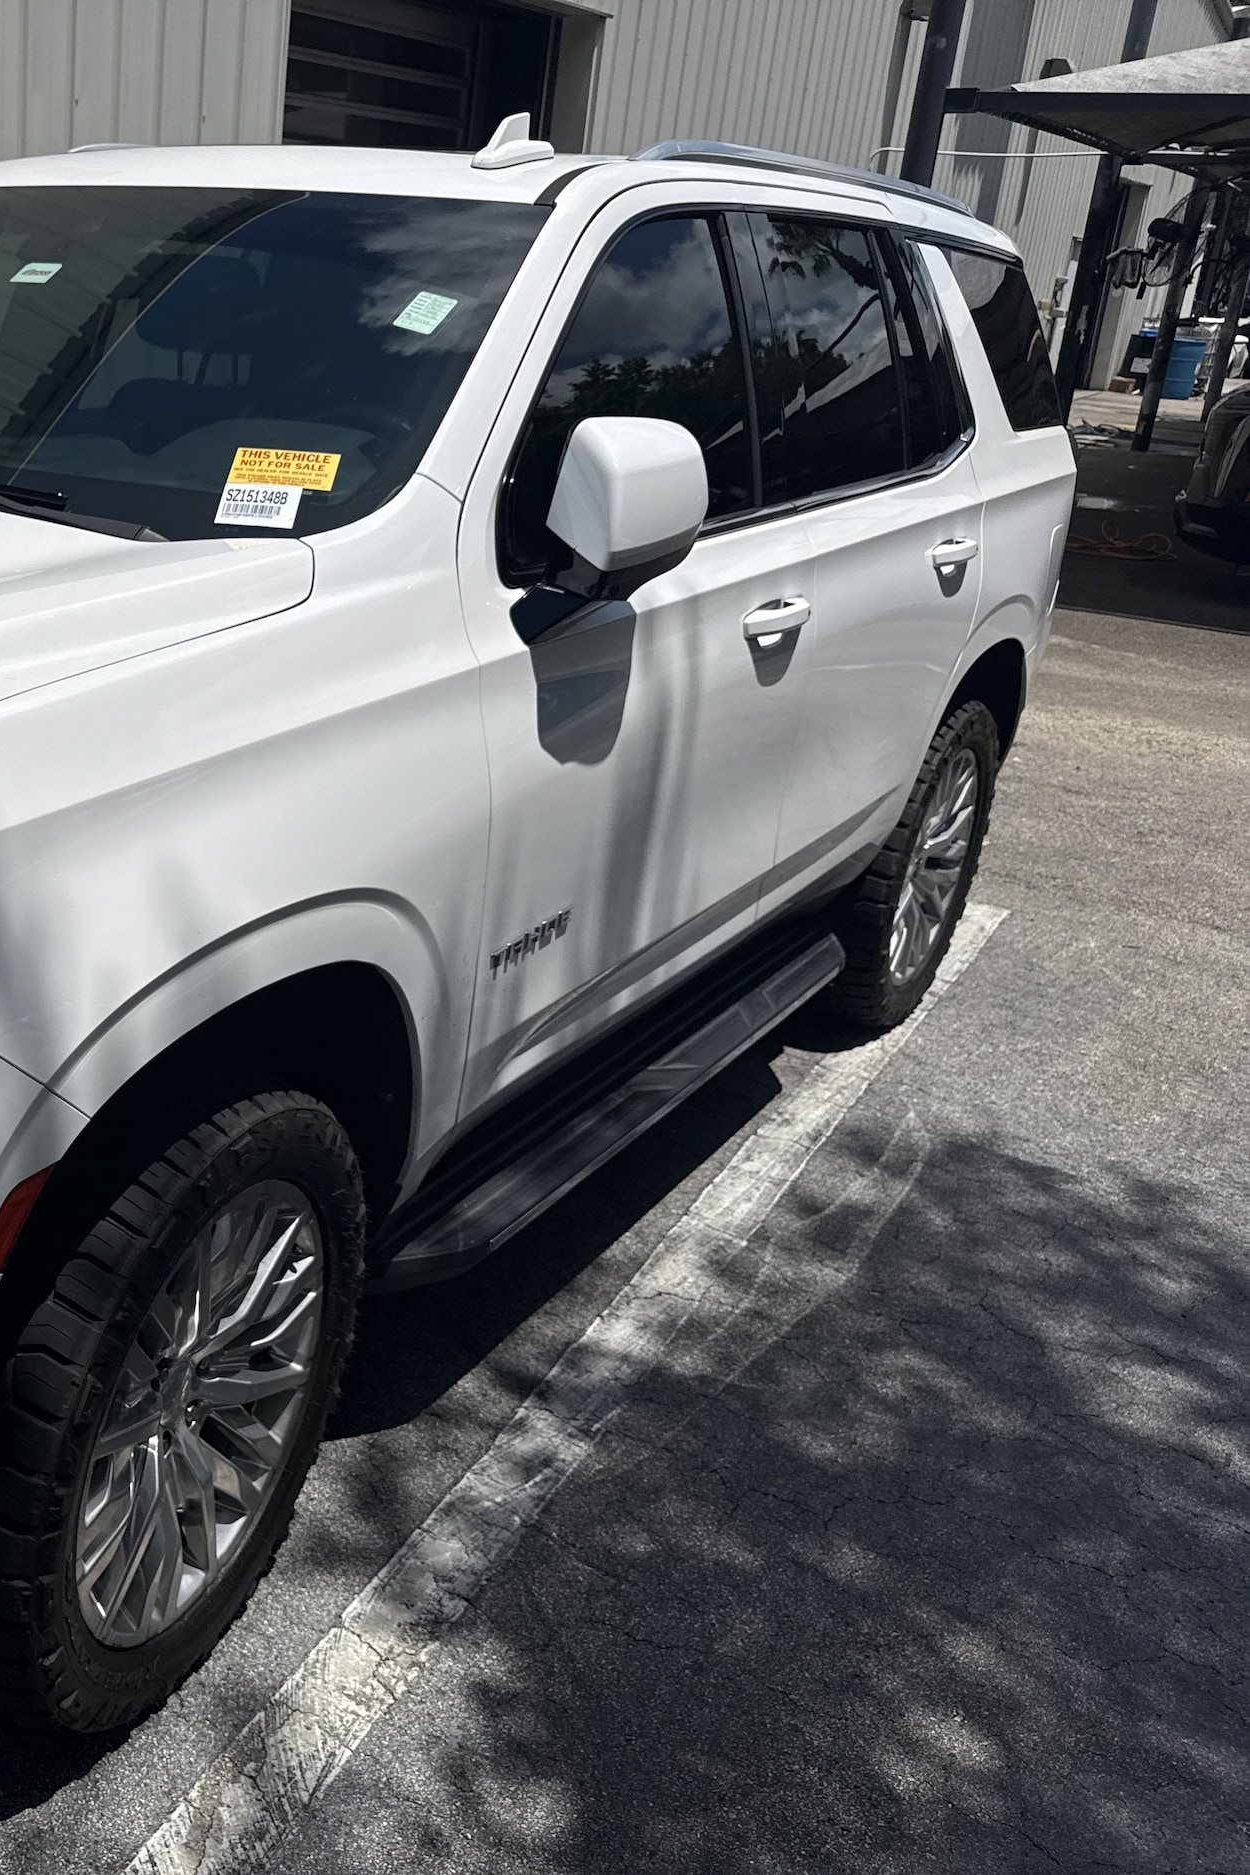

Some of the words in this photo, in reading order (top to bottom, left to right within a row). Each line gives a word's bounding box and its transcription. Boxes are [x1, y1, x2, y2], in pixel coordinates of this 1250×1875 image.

[241, 450, 270, 459] THIS
[275, 452, 331, 463] VEHICLE
[240, 459, 264, 467] NOT
[267, 461, 291, 469] FOR
[295, 463, 326, 472] SALE
[226, 489, 288, 504] SZ151348B
